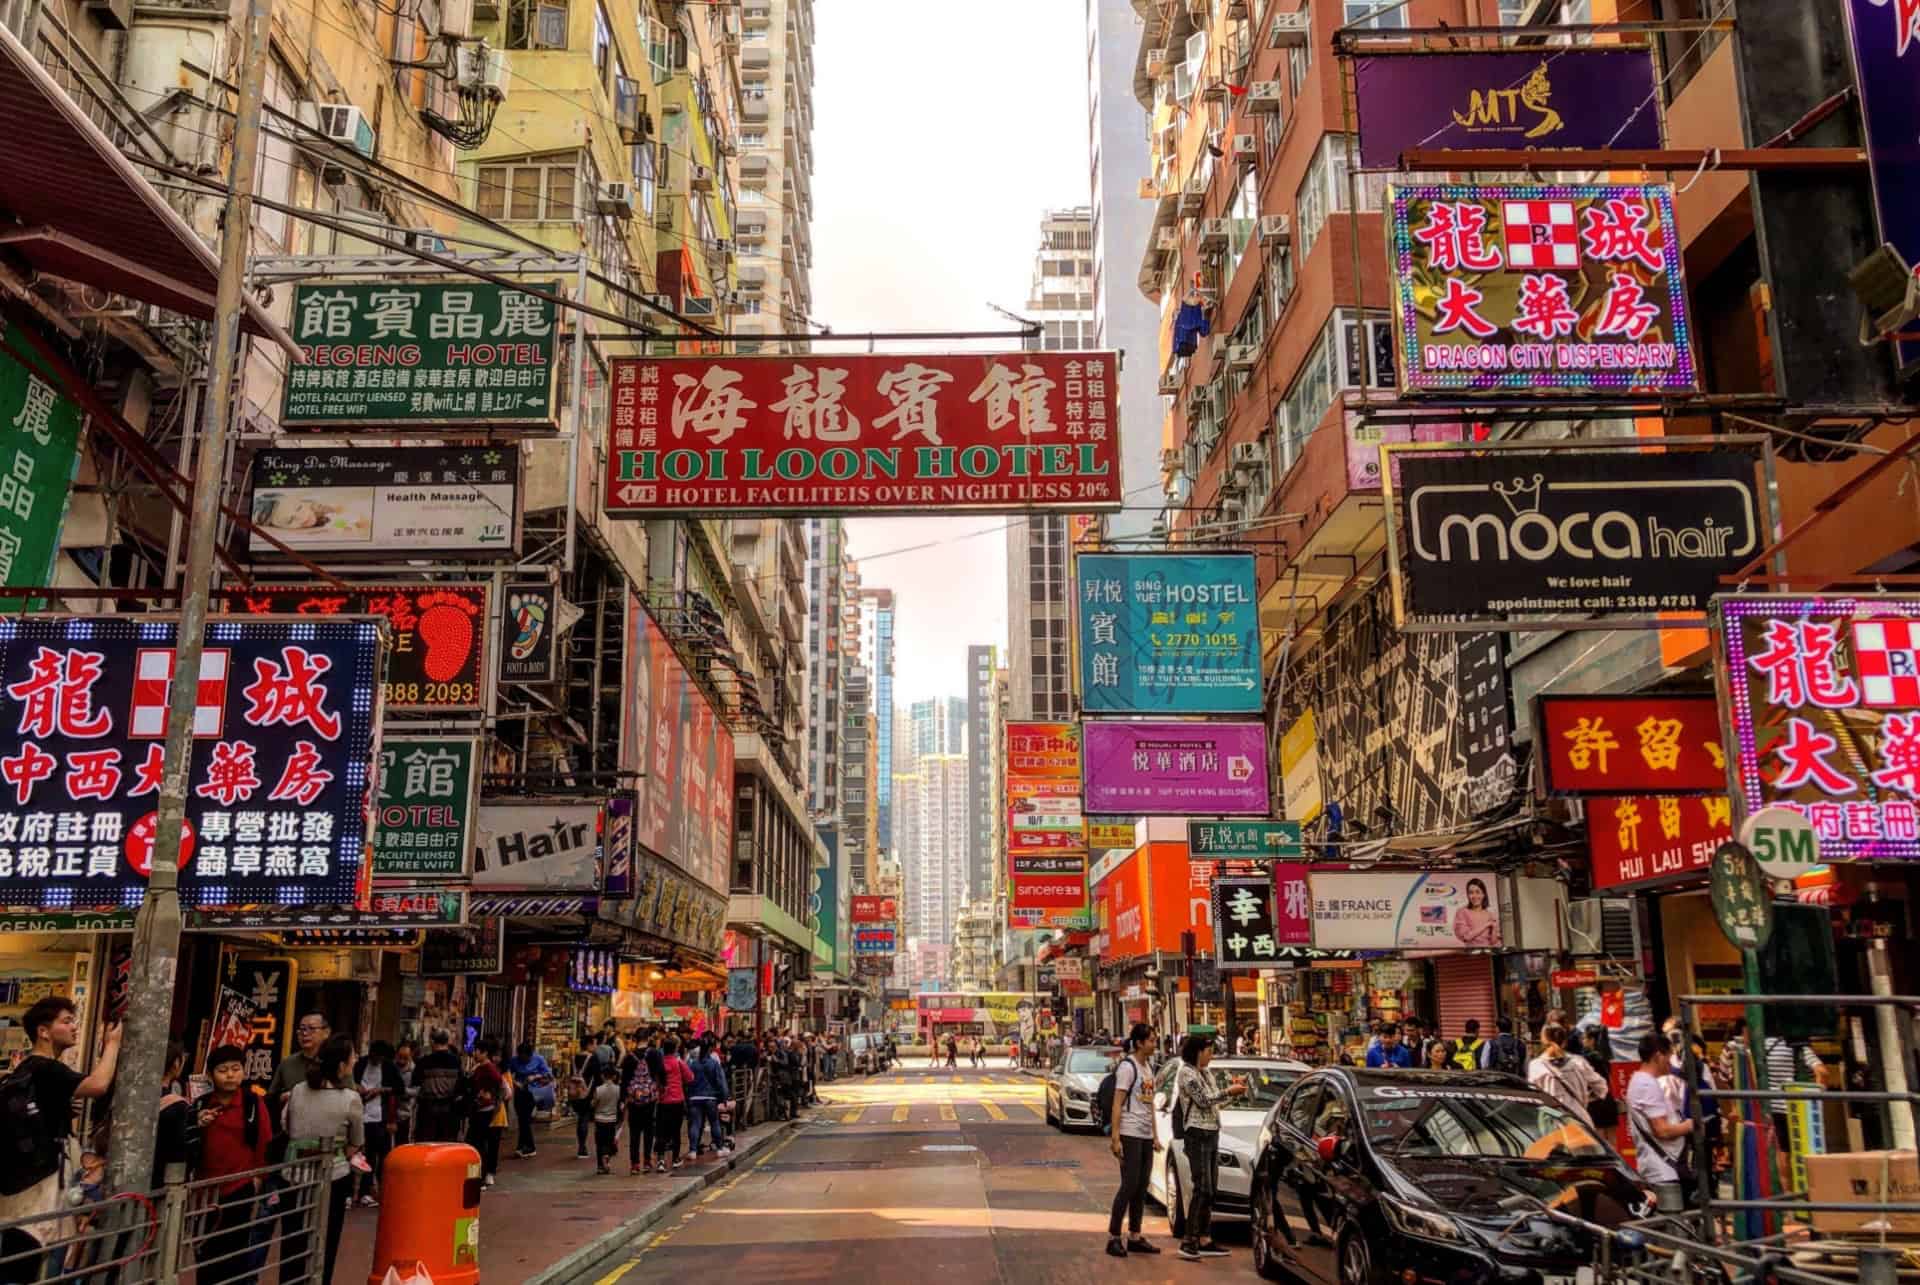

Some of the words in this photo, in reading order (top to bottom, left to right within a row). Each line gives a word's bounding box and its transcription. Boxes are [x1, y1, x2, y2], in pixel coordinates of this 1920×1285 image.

[1434, 273, 1660, 339] 大藥房
[447, 344, 547, 366] HOTEL
[1424, 344, 1508, 369] DRAGON
[1511, 343, 1554, 368] CITY
[1557, 343, 1673, 368] DISPENSARY
[289, 405, 320, 415] HOTEL
[322, 405, 345, 415] FREE
[290, 392, 322, 403] HOTEL
[323, 392, 365, 402] FACILITY
[616, 365, 636, 447] 酒店設備
[671, 363, 1057, 444] 海龍賓館
[1064, 360, 1084, 440] 全日特平
[1086, 360, 1107, 440] 時租過夜
[616, 449, 726, 481] HOI
[741, 447, 898, 481] LOON
[914, 444, 1109, 480] HOTEL
[386, 492, 426, 502] Health
[431, 491, 483, 503] Massage
[666, 488, 743, 504] HOTEL
[876, 485, 935, 501] OVER
[941, 485, 1016, 500] NIGHT
[1020, 485, 1072, 499] LESS
[1078, 484, 1110, 498] 20%
[1439, 511, 1643, 560] moca
[1649, 518, 1734, 558] hair
[1166, 584, 1249, 603] HOSTEL
[1547, 577, 1568, 588] We
[1570, 577, 1600, 588] love
[1602, 576, 1632, 587] hair
[1488, 597, 1581, 610] appointment
[1583, 596, 1614, 609] call:
[1617, 596, 1657, 608] 2388
[1660, 595, 1697, 607] 4781
[1167, 634, 1199, 646] 2770
[1205, 634, 1237, 645] 1015
[1751, 620, 1857, 708] 龍
[8, 647, 112, 739] 龍
[243, 645, 341, 740] 城
[424, 683, 473, 702] 2093
[199, 811, 336, 842] 專營批發
[377, 805, 460, 828] OTEL
[1772, 800, 1917, 840] 府註冊
[496, 823, 588, 867] Hair
[1620, 856, 1644, 880] HUI
[1652, 848, 1683, 873] LAU
[1692, 836, 1733, 864] SH
[1753, 828, 1815, 864] 5M
[196, 846, 331, 878] 蟲草燕窩
[388, 860, 420, 870] FREE
[1341, 900, 1392, 911] FRANCE
